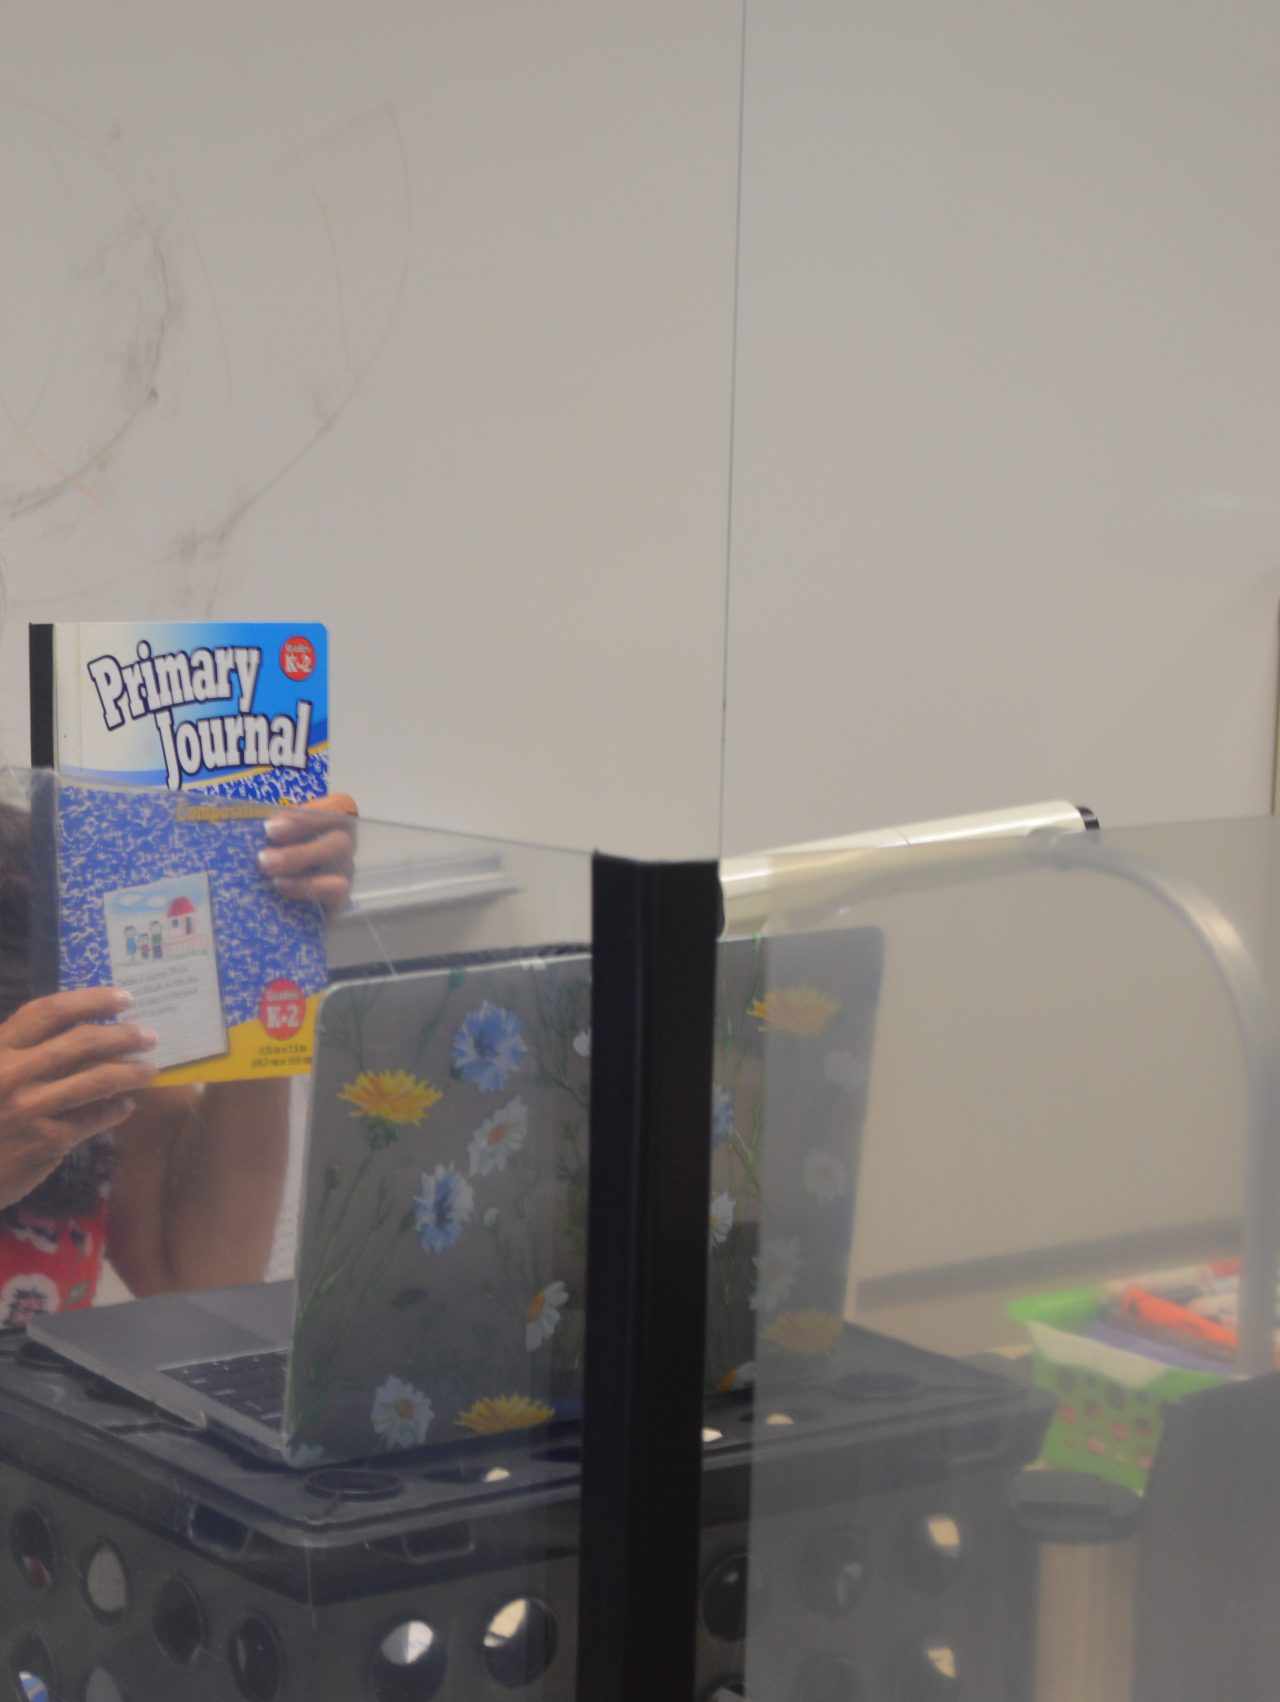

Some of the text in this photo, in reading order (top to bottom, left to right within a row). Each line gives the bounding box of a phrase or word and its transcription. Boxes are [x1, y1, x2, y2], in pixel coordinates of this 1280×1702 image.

[87, 639, 262, 731] Primary
[154, 699, 313, 791] Journal
[267, 1004, 299, 1029] K-2
